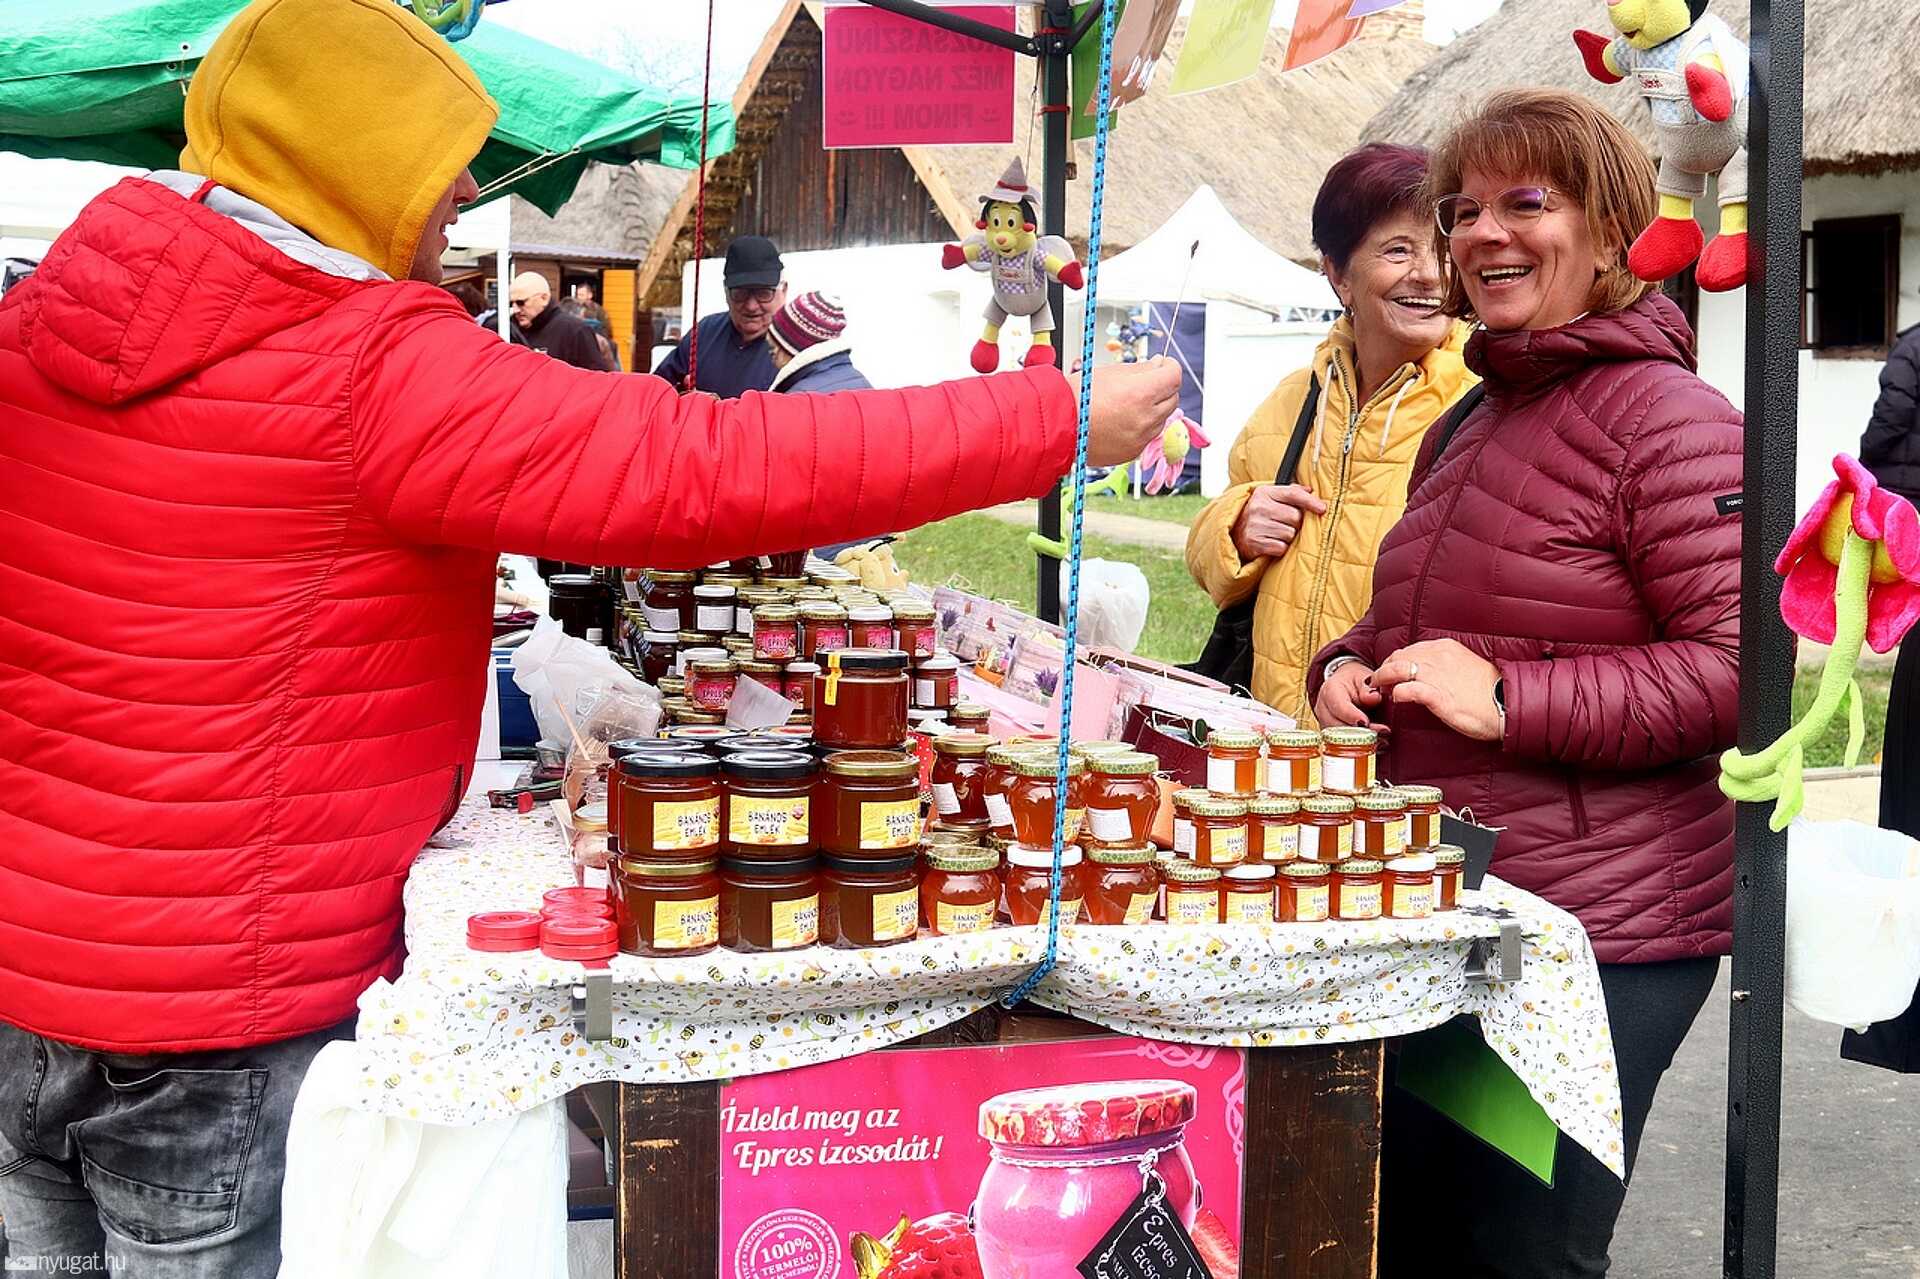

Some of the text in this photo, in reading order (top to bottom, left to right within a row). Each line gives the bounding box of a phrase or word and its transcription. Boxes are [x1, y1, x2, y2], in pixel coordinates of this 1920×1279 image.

[677, 811, 711, 827] BANÁNOS
[748, 810, 788, 823] BANÁNOS
[721, 1098, 900, 1137] Ízleld meg az
[733, 1134, 944, 1176] Epres ízcsodát!
[760, 1235, 813, 1263] 100%
[1142, 1215, 1178, 1268] Epres
[761, 1252, 819, 1276] TERMELŐI
